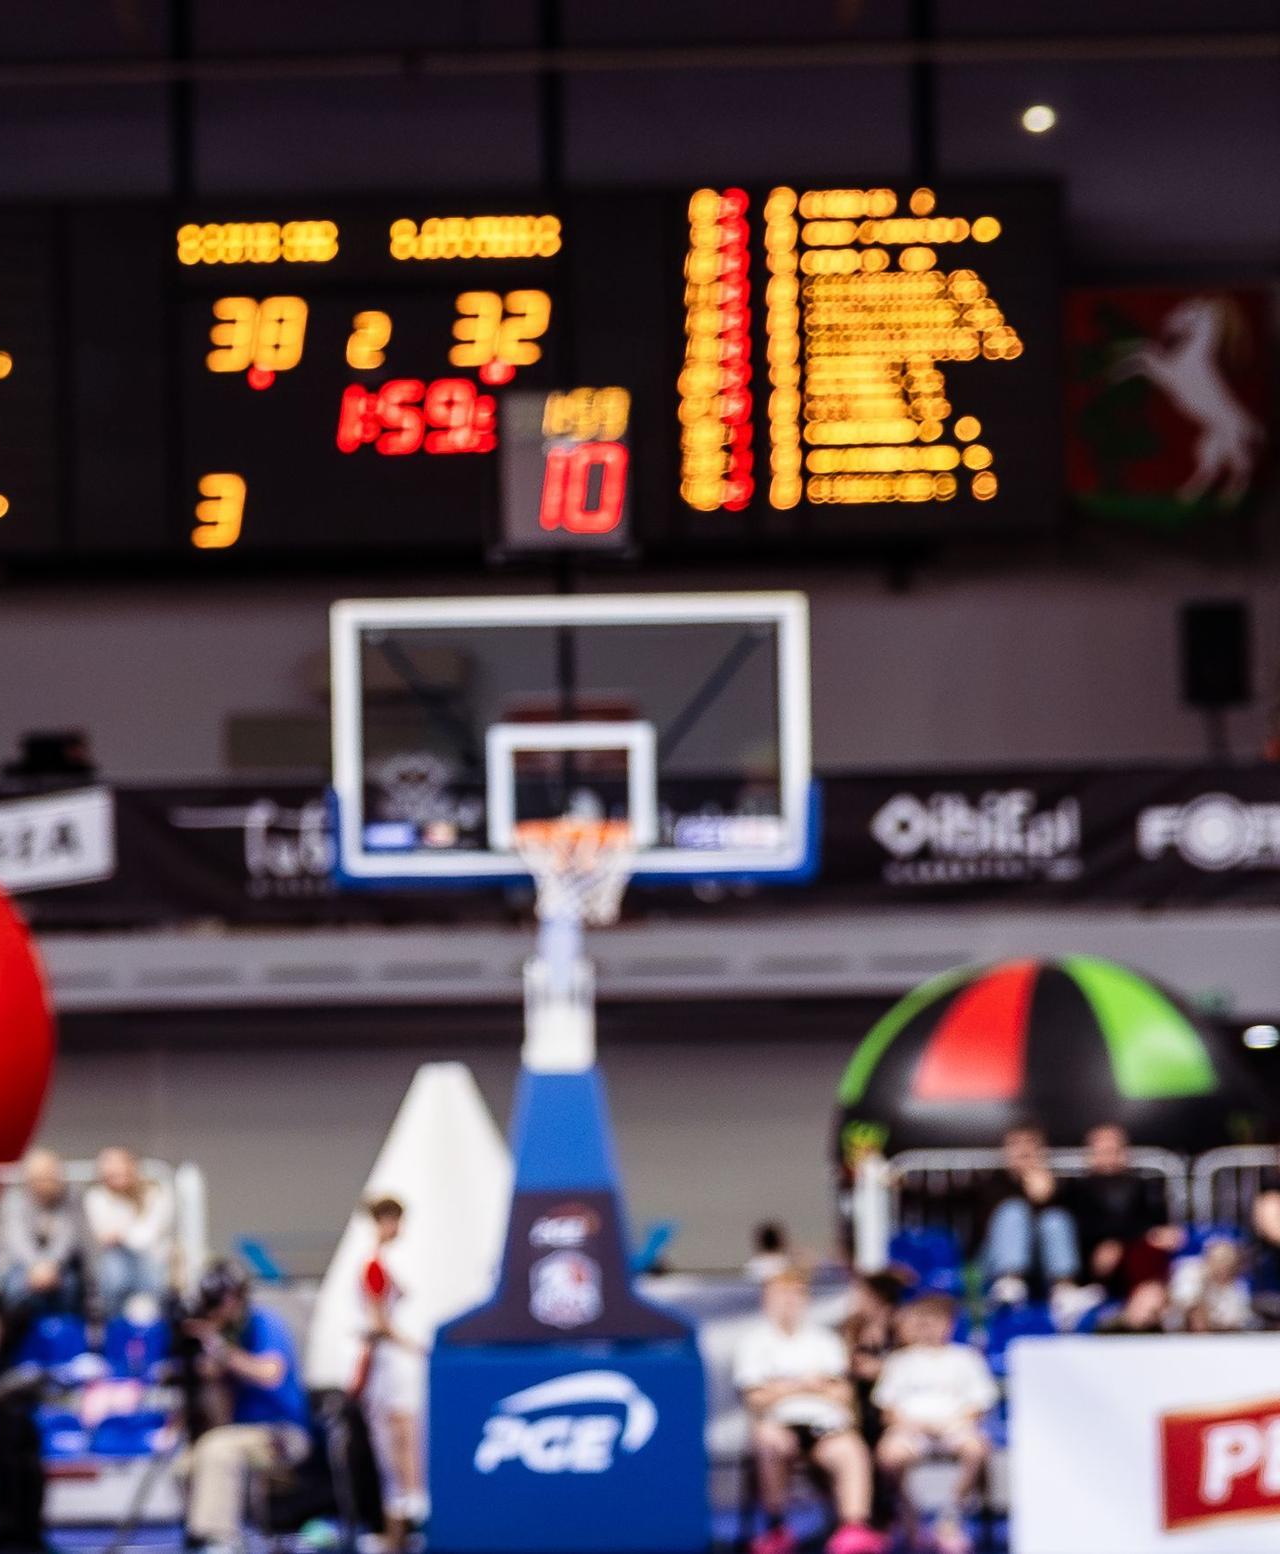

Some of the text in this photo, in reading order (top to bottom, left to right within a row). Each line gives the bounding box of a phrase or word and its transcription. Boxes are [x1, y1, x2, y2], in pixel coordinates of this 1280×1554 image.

[346, 311, 392, 369] 2
[449, 290, 551, 367] 32
[191, 473, 247, 549] 3
[540, 441, 628, 534] 10
[474, 1414, 622, 1475] PGE
